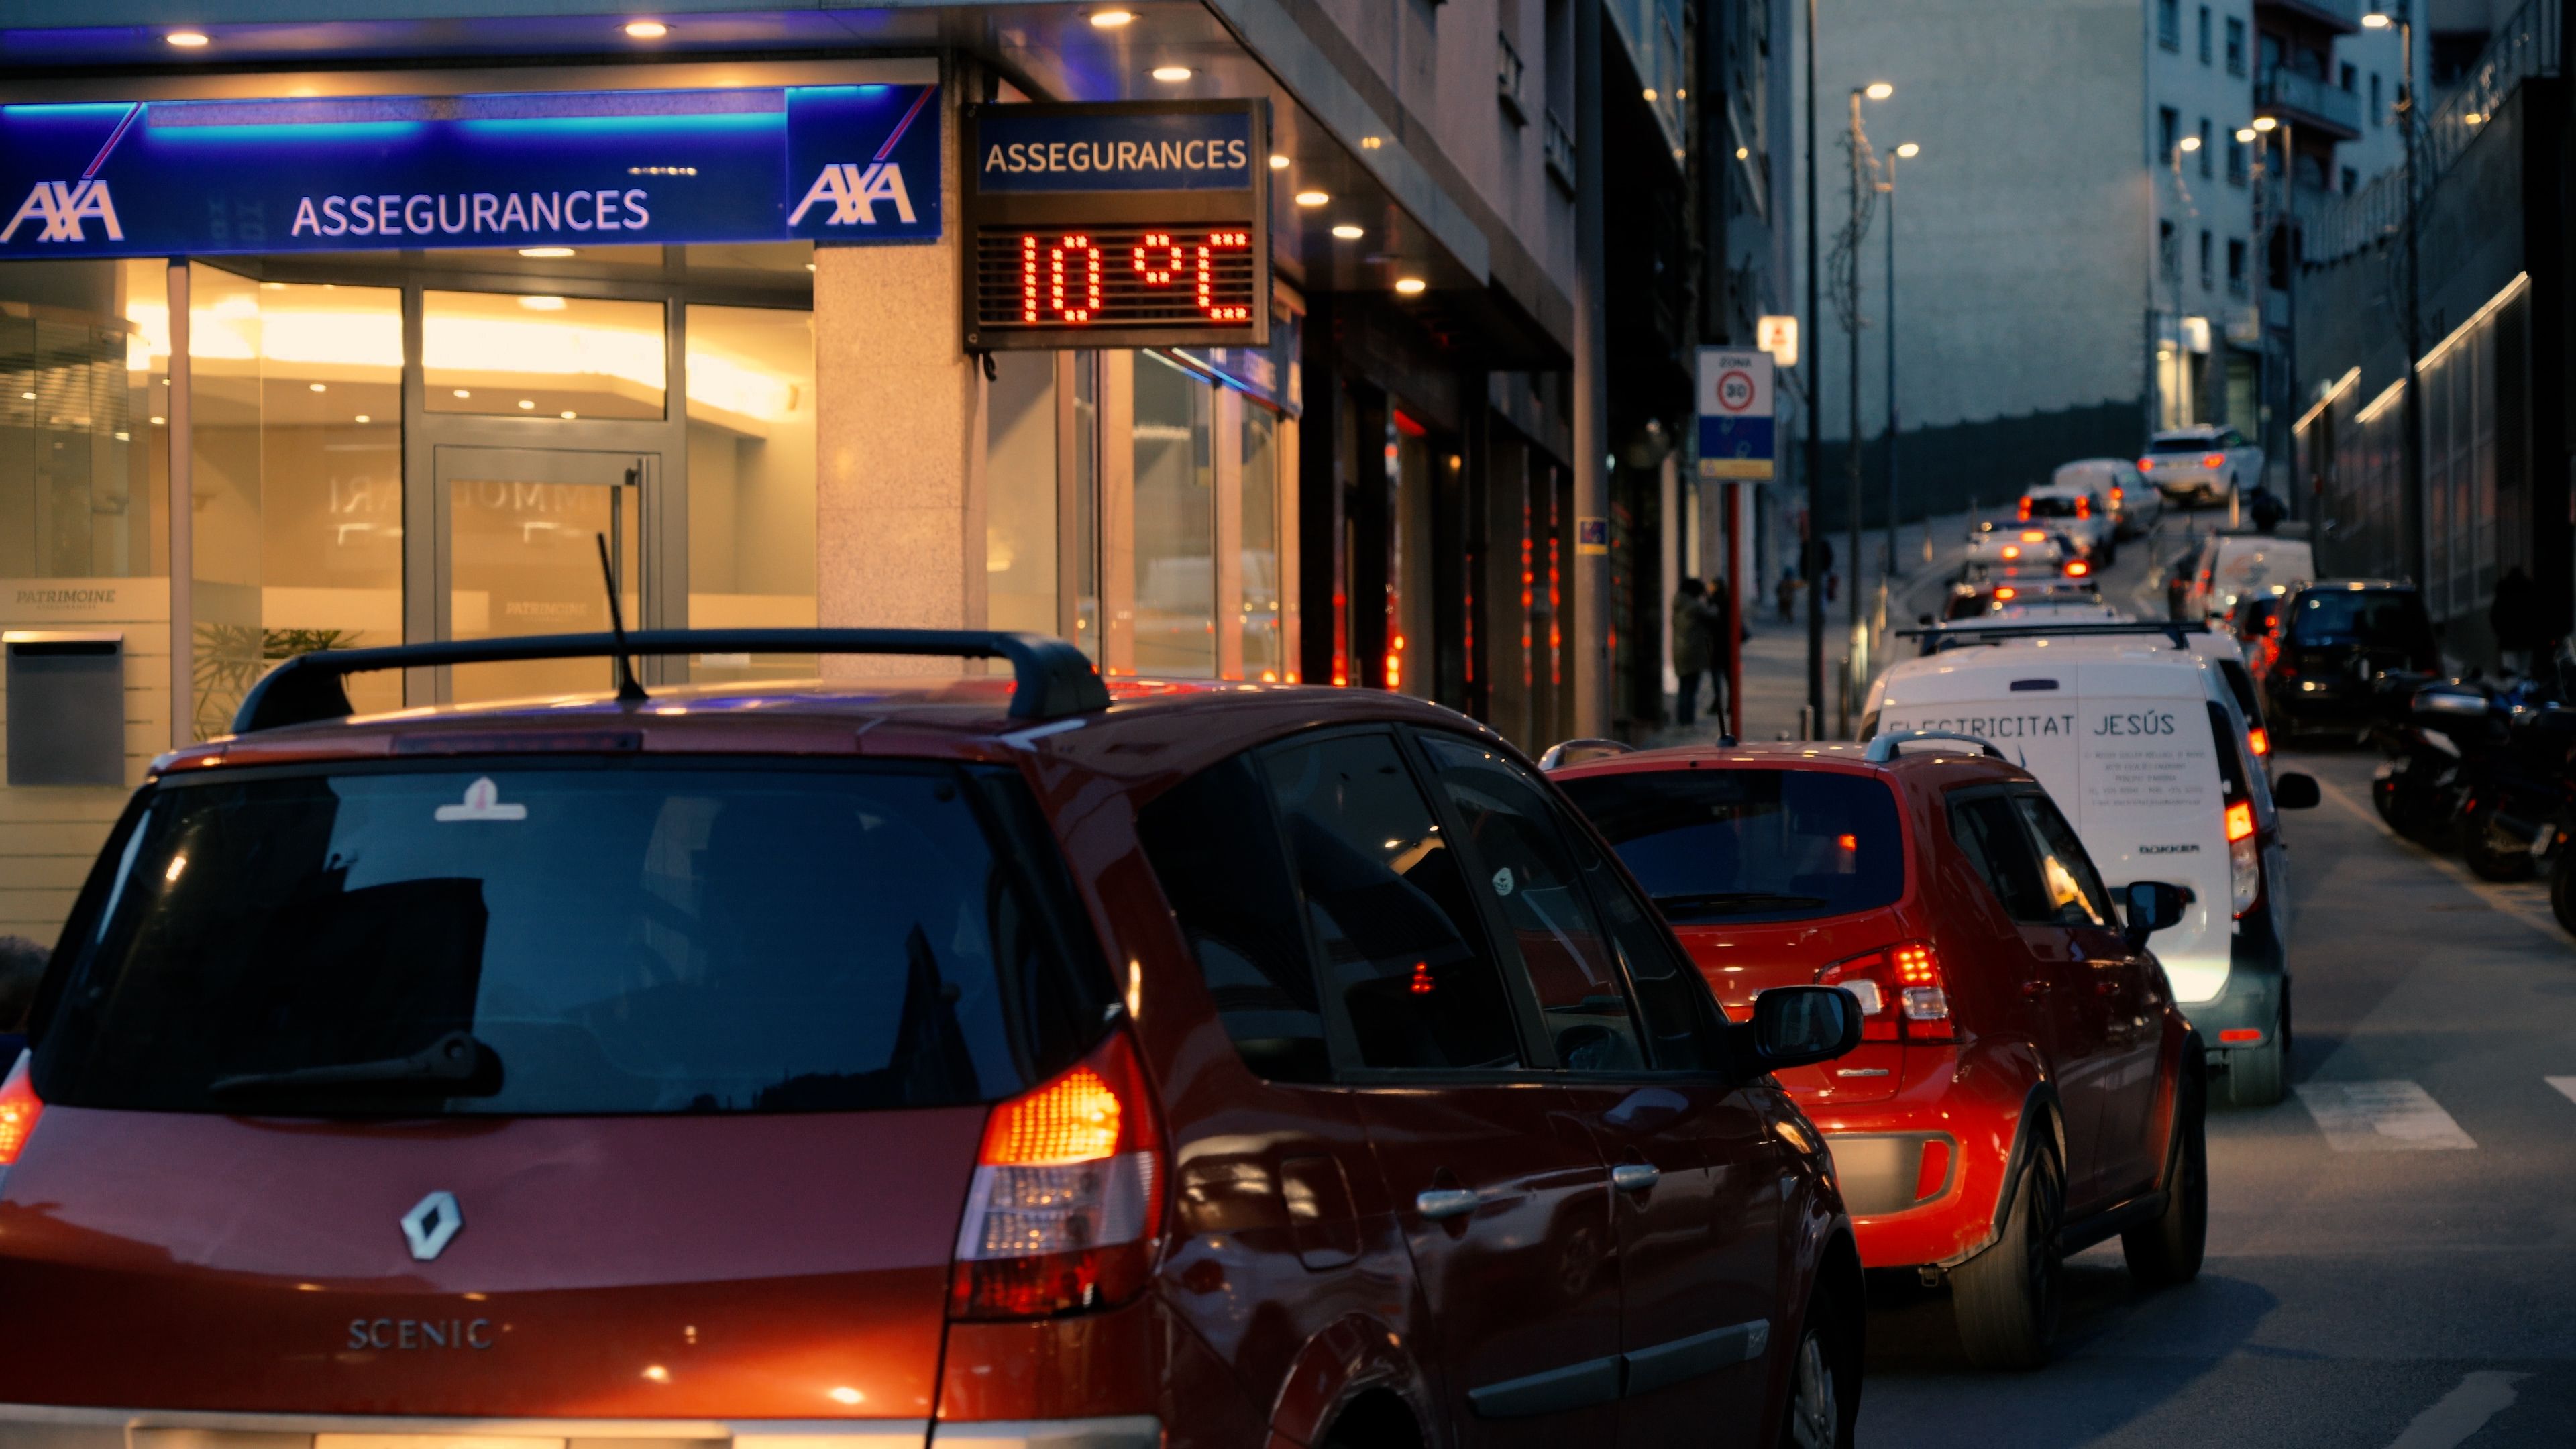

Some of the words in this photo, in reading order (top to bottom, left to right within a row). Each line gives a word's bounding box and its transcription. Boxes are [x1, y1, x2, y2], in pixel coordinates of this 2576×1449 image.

[986, 140, 1247, 172] ASSEGURANCES
[788, 163, 917, 225] AXA
[0, 180, 125, 243] AXA
[292, 190, 650, 237] ASSEGURANCES
[1022, 235, 1104, 323] 10
[1720, 358, 1752, 367] ZONA
[1727, 383, 1746, 398] 30
[16, 590, 116, 603] PATRIMOINE
[2094, 710, 2175, 736] JESÚS
[347, 1319, 492, 1350] SCENIC
